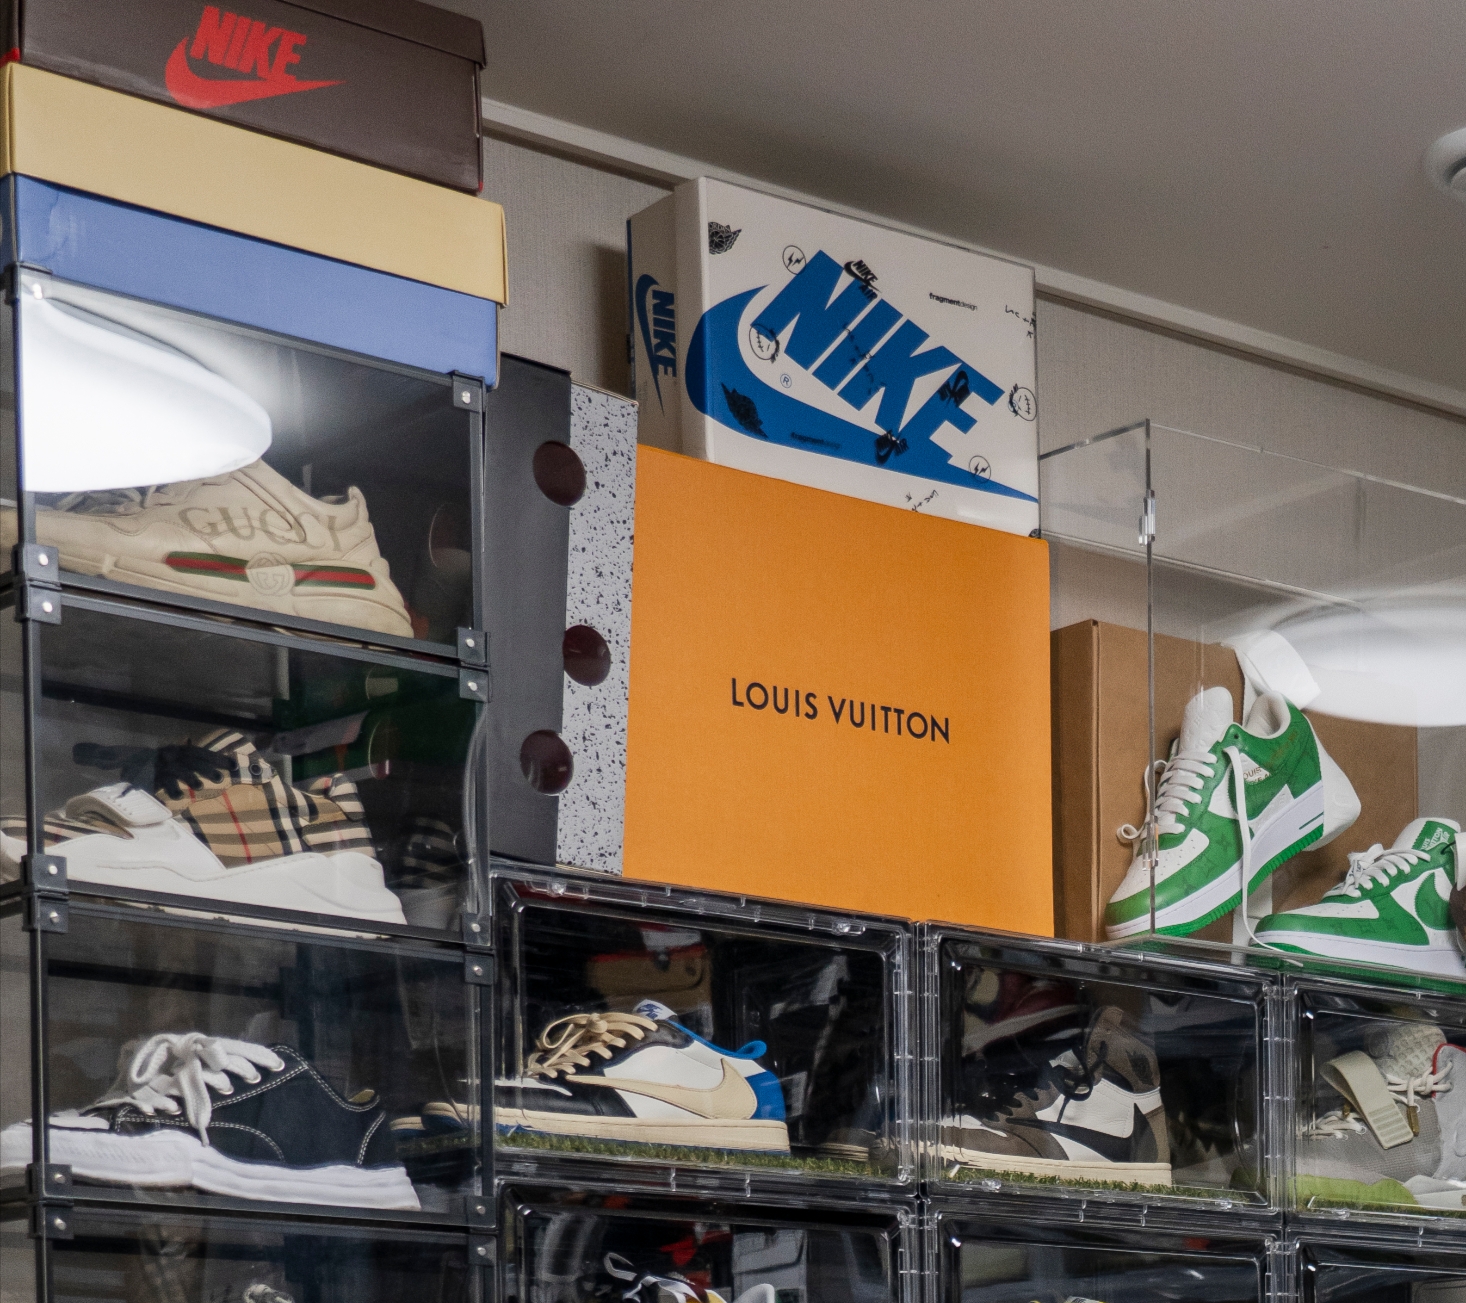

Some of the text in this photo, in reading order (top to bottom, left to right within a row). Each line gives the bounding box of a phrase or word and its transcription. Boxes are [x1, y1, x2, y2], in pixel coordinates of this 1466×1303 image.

[190, 5, 307, 83] NIKE
[853, 260, 878, 283] NIKE
[652, 290, 677, 378] NIKE
[750, 249, 1006, 464] NIKE
[178, 503, 342, 553] GUCCI
[731, 677, 951, 745] LOUIS VUITTON
